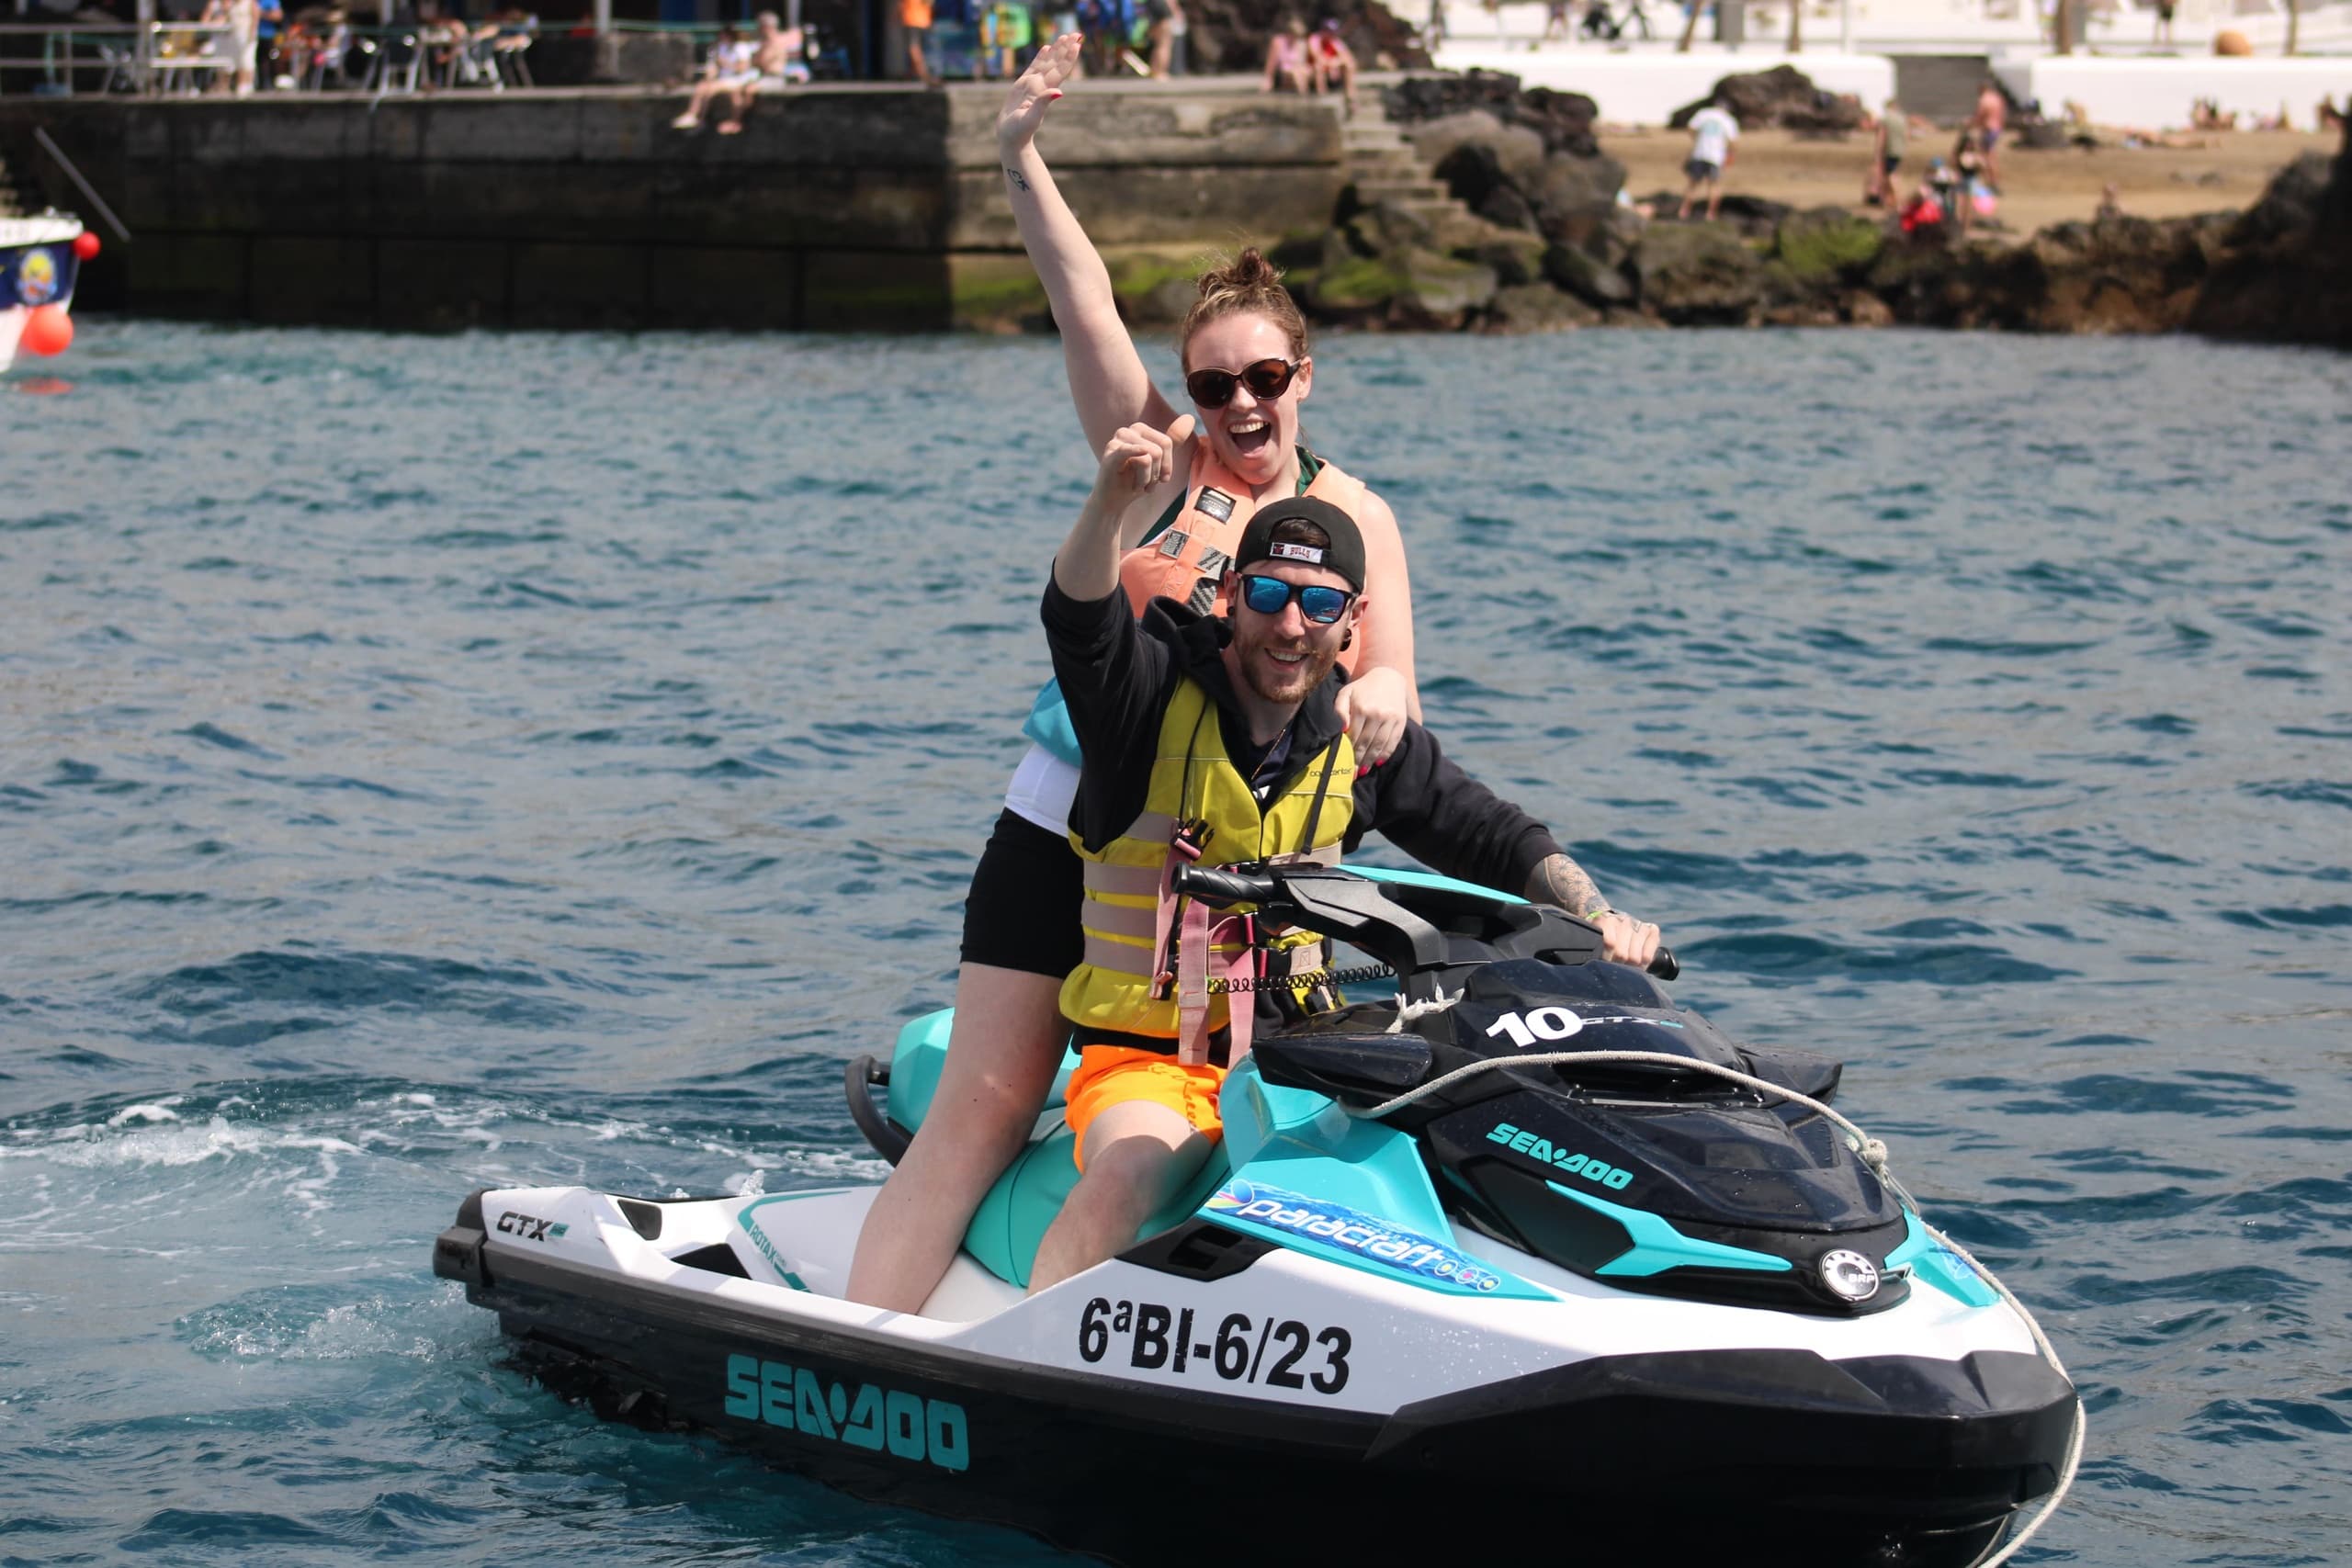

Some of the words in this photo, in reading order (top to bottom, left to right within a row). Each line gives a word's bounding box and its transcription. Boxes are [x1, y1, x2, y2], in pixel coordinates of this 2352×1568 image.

[1485, 1006, 1584, 1047] 10
[497, 1211, 554, 1242] GTX
[749, 1224, 776, 1265] ROTAX
[1848, 1273, 1875, 1283] BRP
